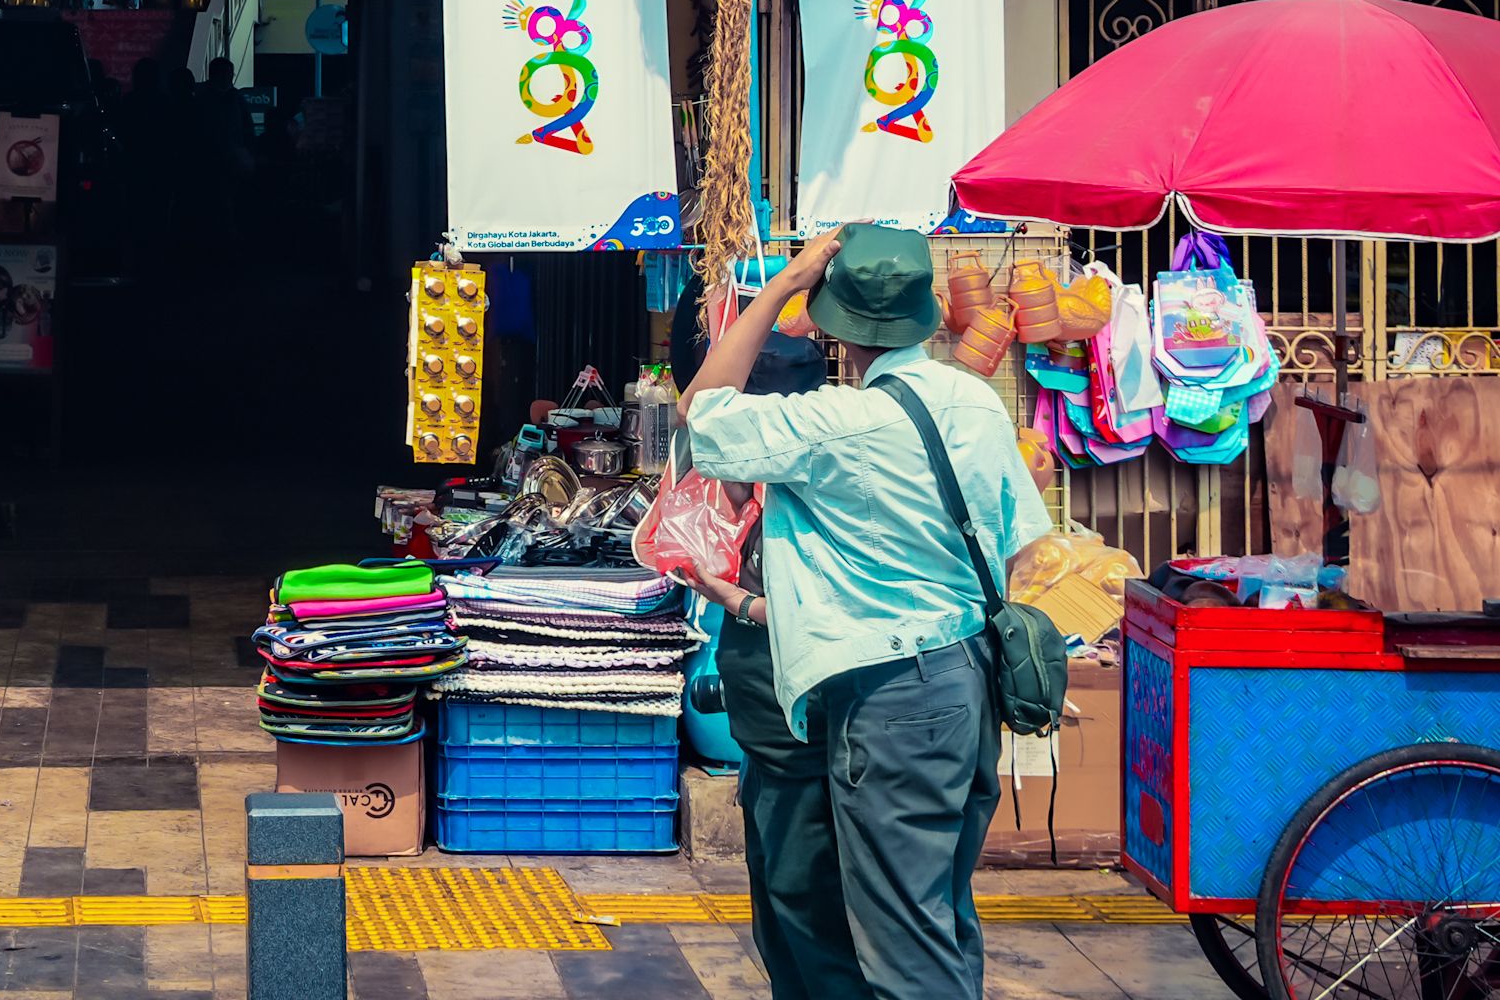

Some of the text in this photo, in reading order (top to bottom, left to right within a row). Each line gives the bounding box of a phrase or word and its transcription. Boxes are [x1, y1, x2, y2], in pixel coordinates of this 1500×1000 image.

[467, 230, 507, 240] Dirgahayu
[508, 230, 528, 239] Kota
[467, 239, 575, 249] Kota Global dan Berbudaya
